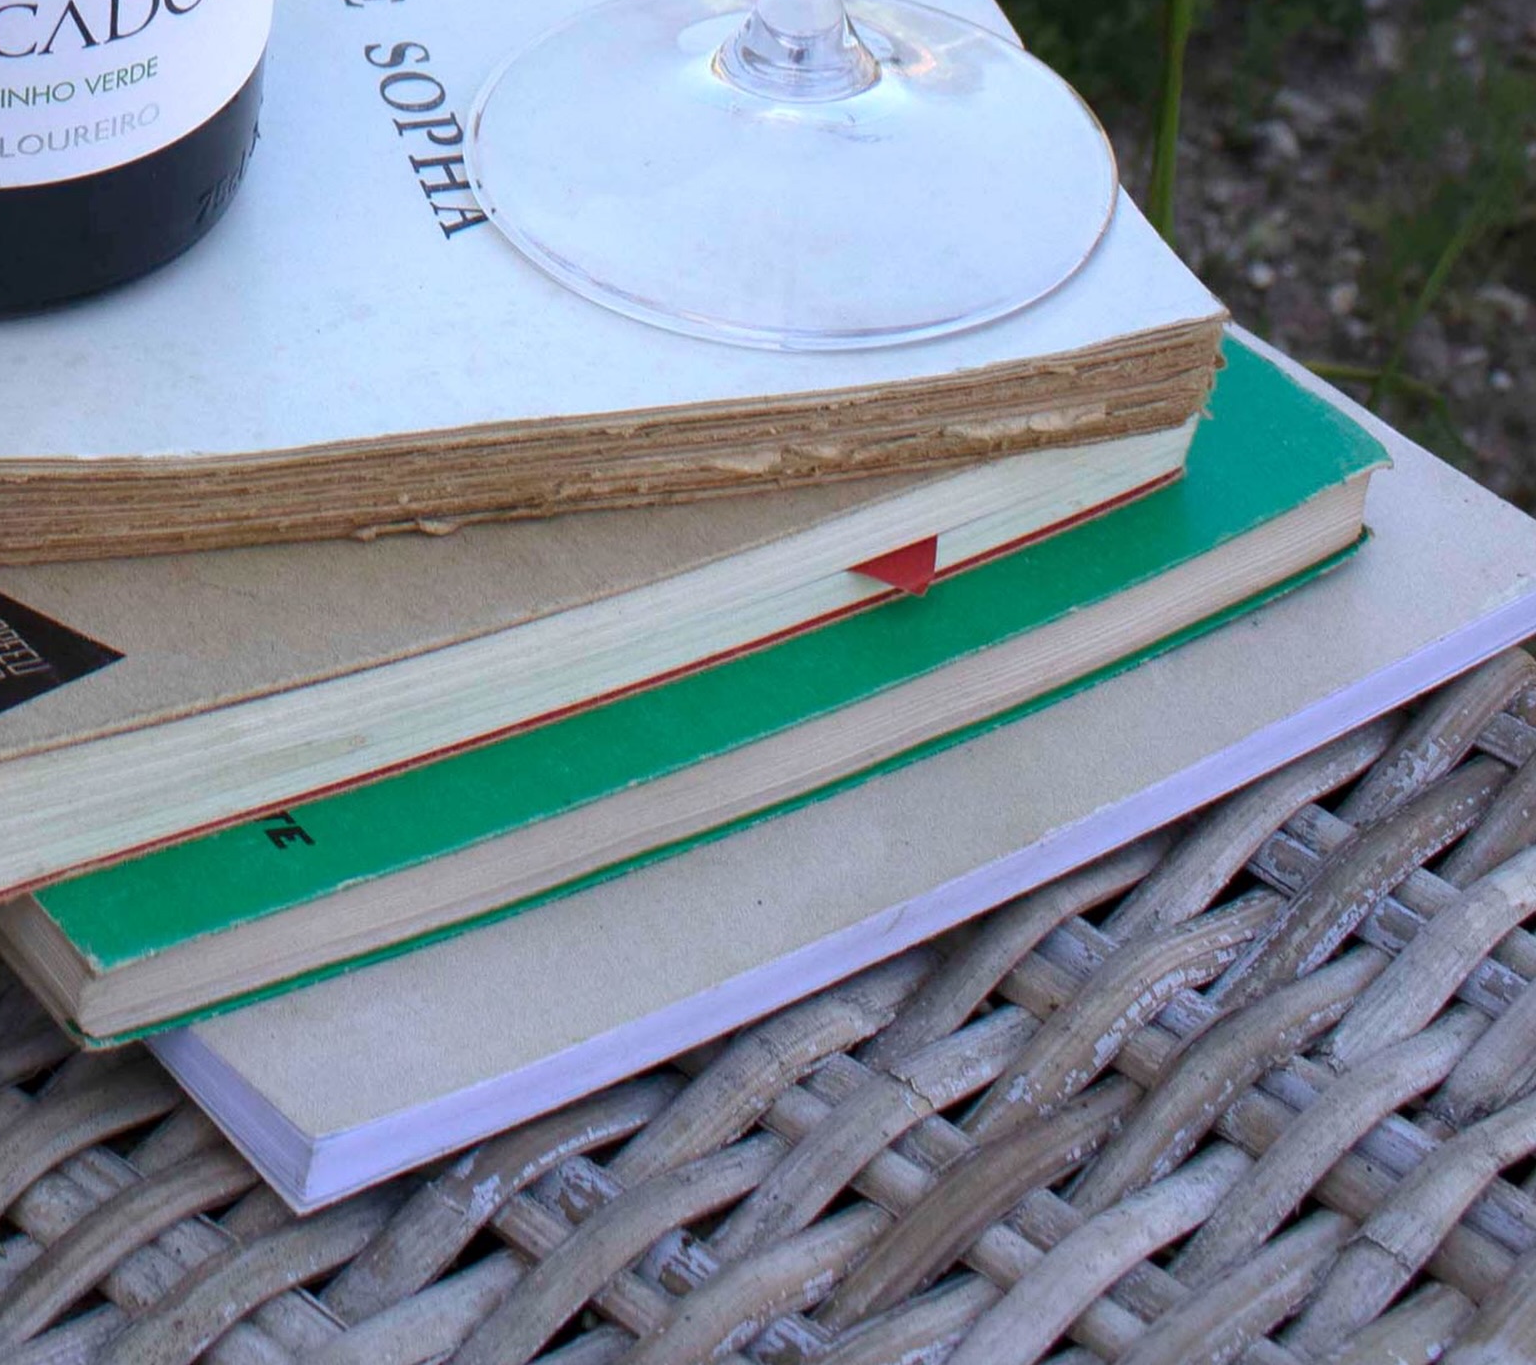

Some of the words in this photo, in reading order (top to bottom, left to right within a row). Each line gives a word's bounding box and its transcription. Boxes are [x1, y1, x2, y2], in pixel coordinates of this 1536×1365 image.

[85, 56, 158, 97] VERDE
[0, 103, 160, 158] LOUREIRO
[364, 41, 497, 240] SOPHA
